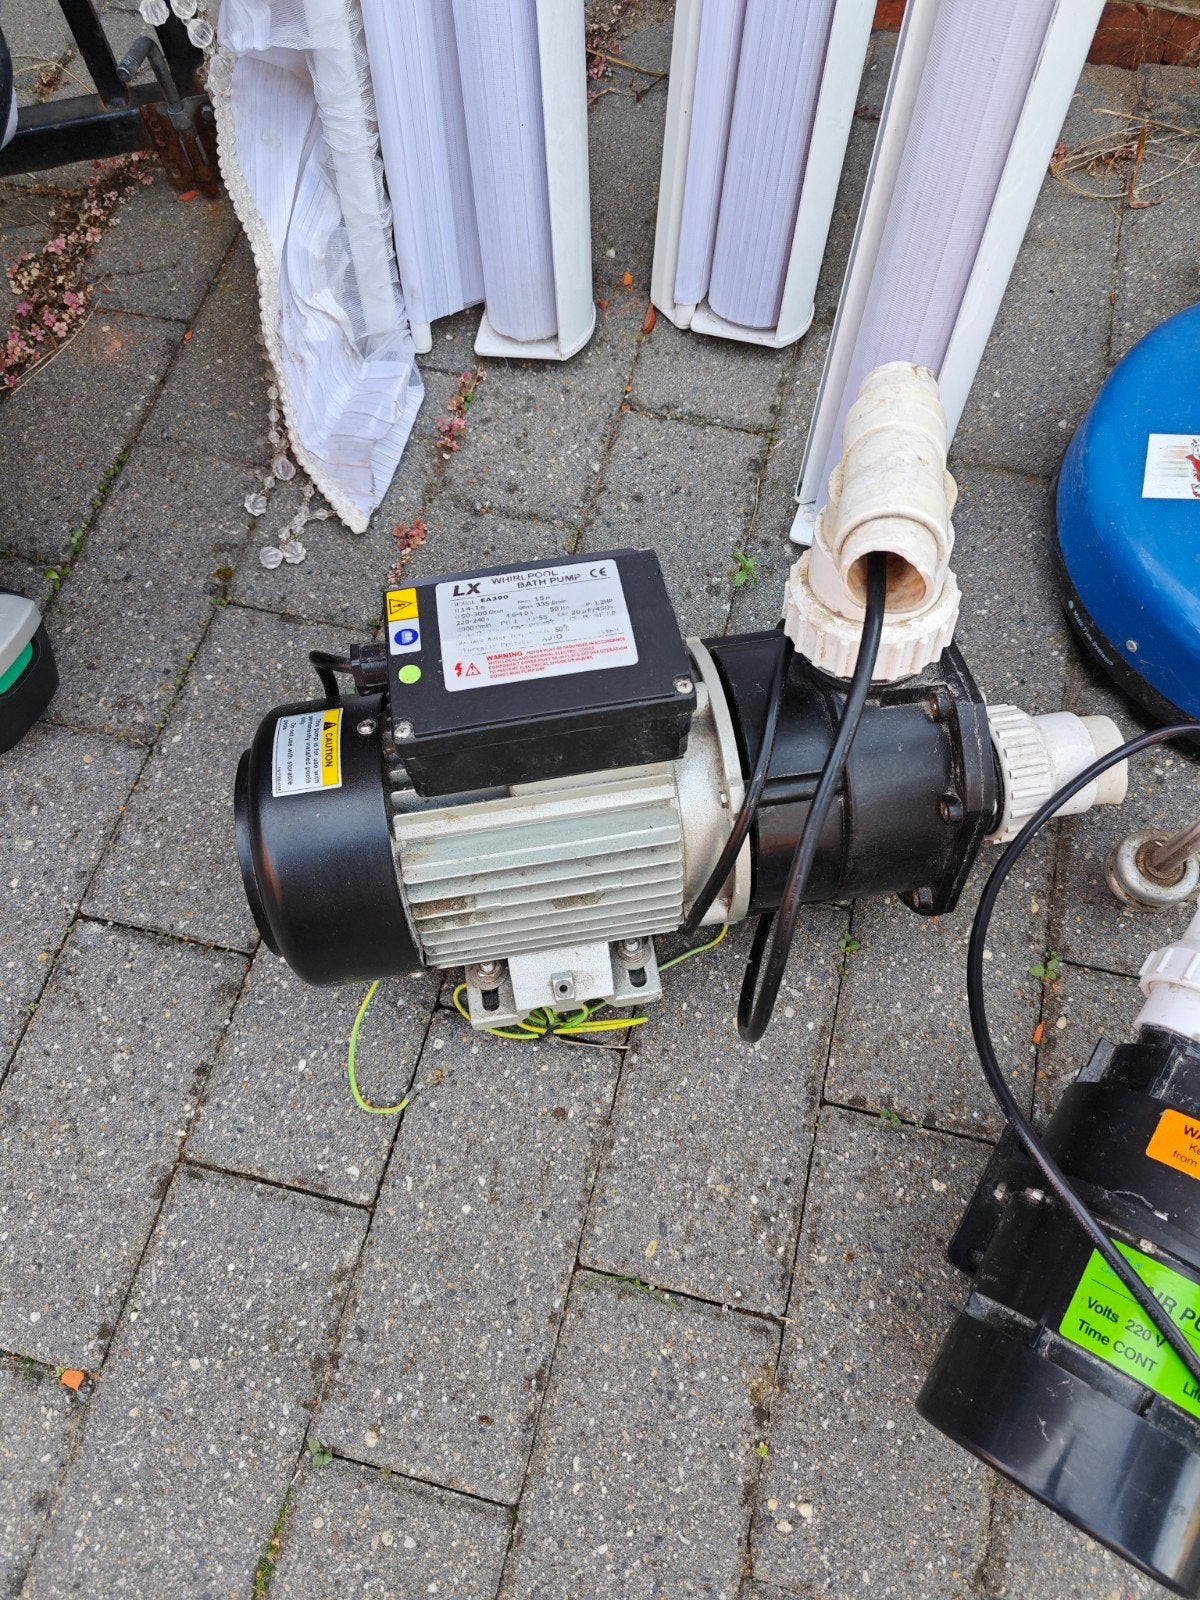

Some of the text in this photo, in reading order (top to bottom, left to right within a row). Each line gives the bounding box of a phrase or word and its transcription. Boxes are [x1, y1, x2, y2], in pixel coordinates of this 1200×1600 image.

[491, 570, 558, 584] WHIRLPOOL
[516, 574, 581, 588] BATH PUMP
[452, 582, 481, 596] LX
[486, 651, 522, 660] WARNING
[324, 732, 333, 767] CAUTION
[1173, 1150, 1198, 1167] from
[1087, 1296, 1167, 1348] Volts 220 V
[1078, 1318, 1110, 1346] Time
[1113, 1340, 1158, 1372] CONT
